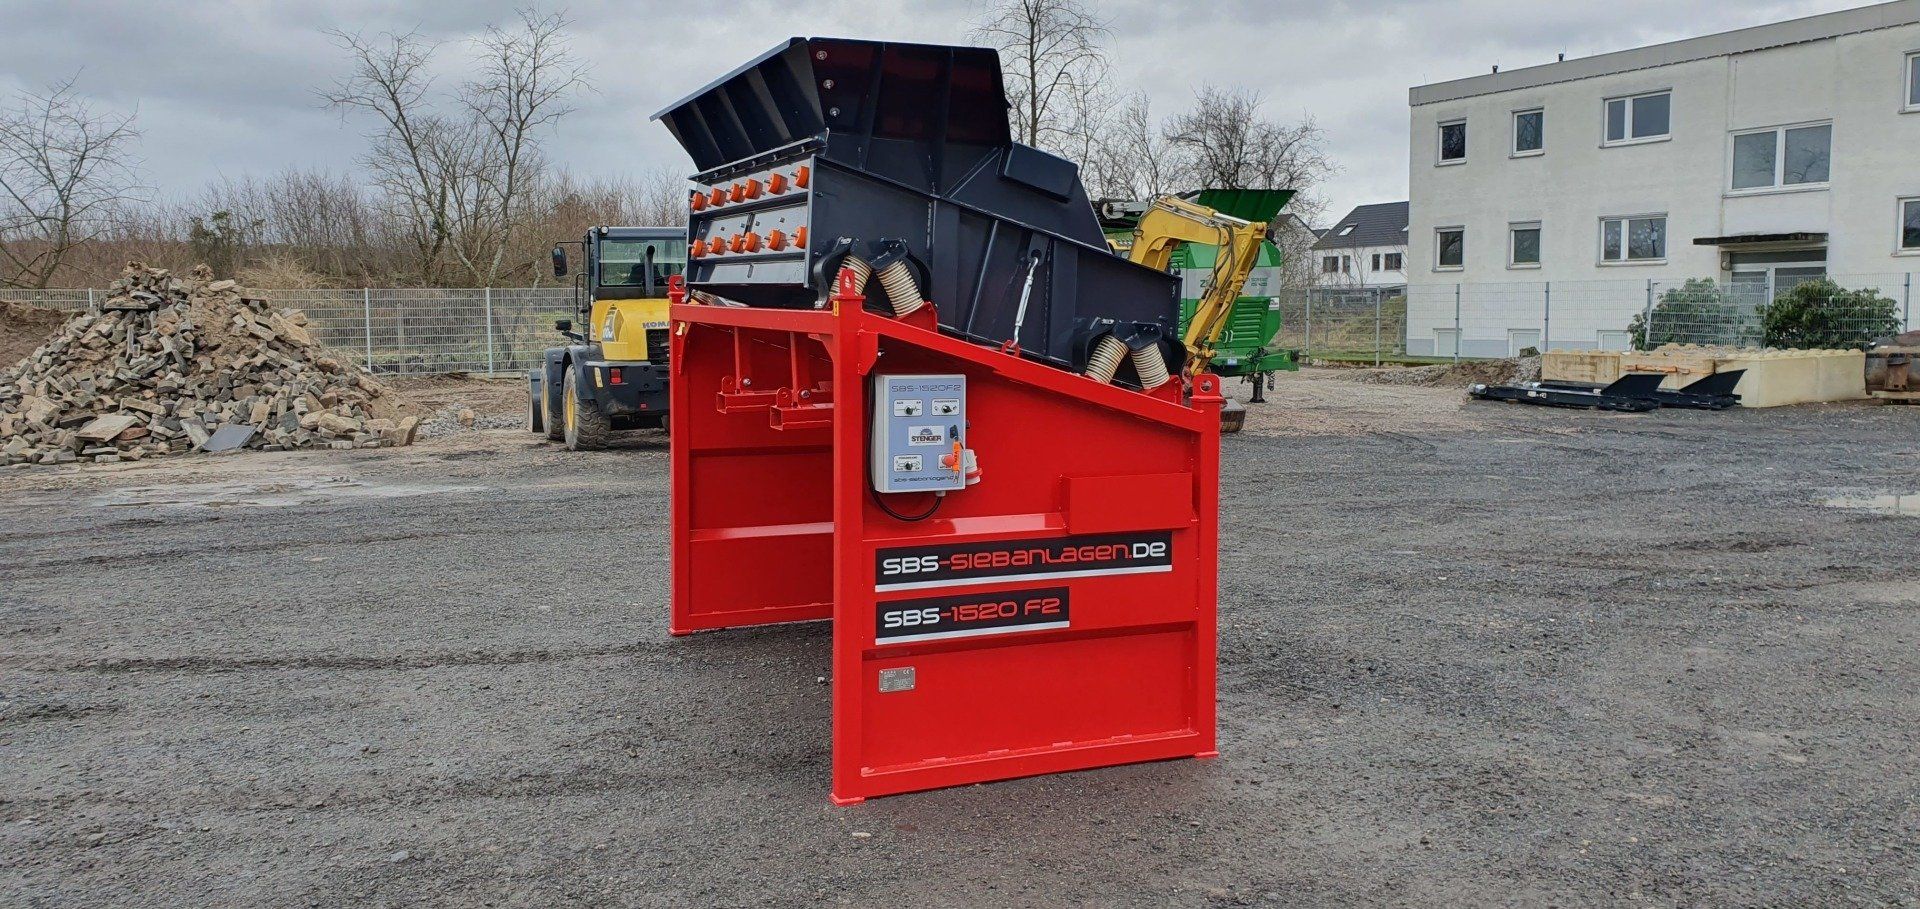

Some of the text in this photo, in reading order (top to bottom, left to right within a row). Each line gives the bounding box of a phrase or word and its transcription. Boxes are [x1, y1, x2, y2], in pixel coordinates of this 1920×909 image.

[882, 541, 1166, 575] SBS-SIEBANLAGEN.DE
[884, 597, 1061, 628] SBS-1520 F2
